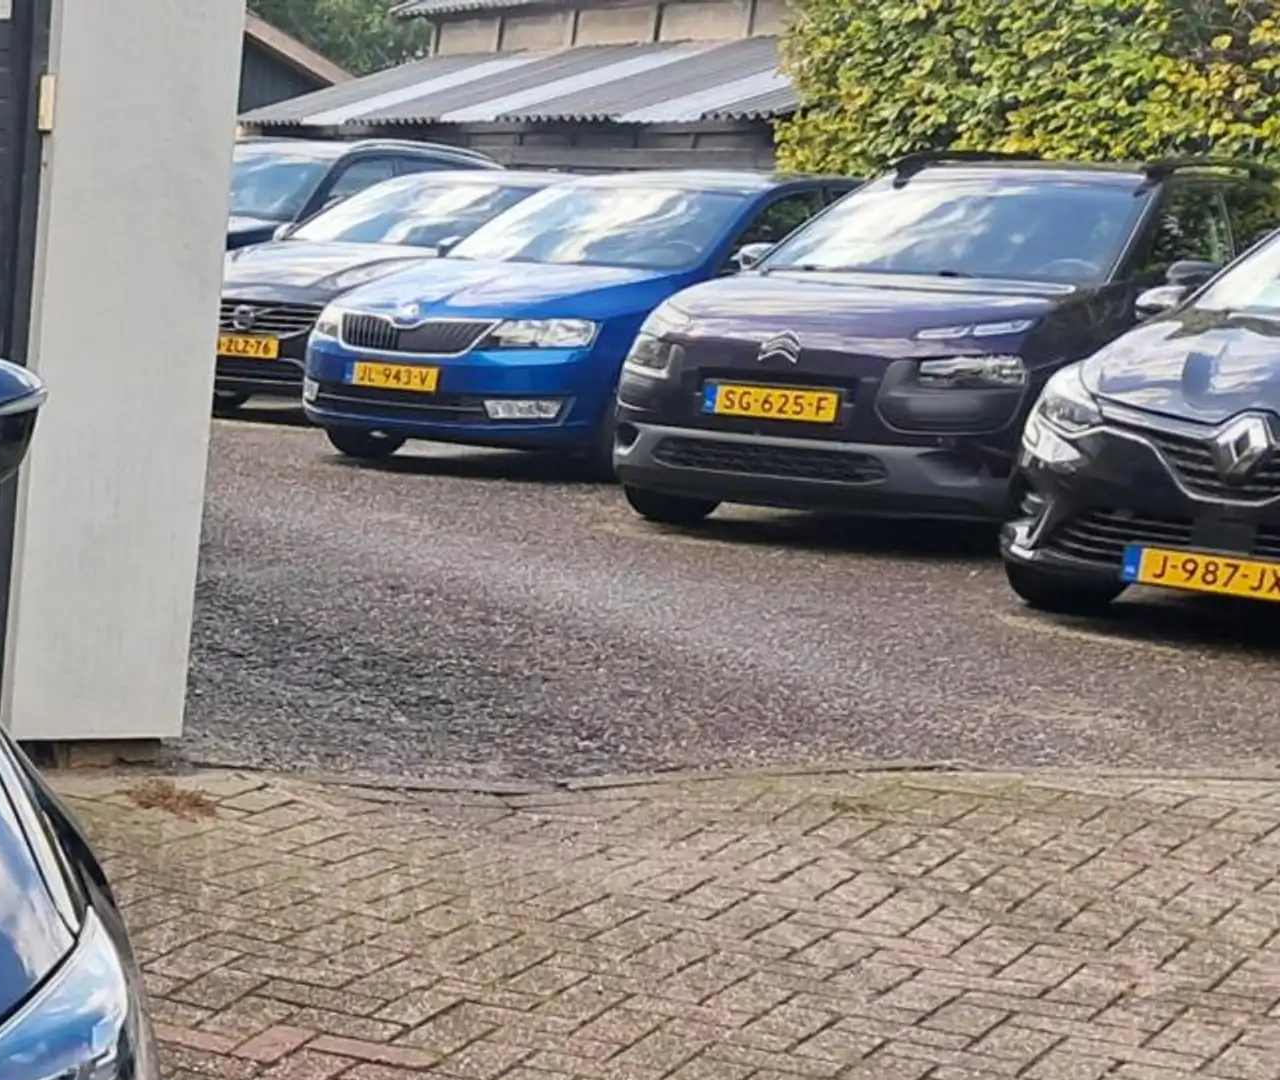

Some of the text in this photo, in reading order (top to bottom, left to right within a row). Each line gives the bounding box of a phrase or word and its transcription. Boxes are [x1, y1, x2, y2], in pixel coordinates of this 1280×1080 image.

[217, 338, 272, 356] -ZLZ-76
[358, 366, 430, 386] JL-943-V
[723, 389, 830, 417] SG-625-F
[1152, 555, 1280, 595] J-987-JX
